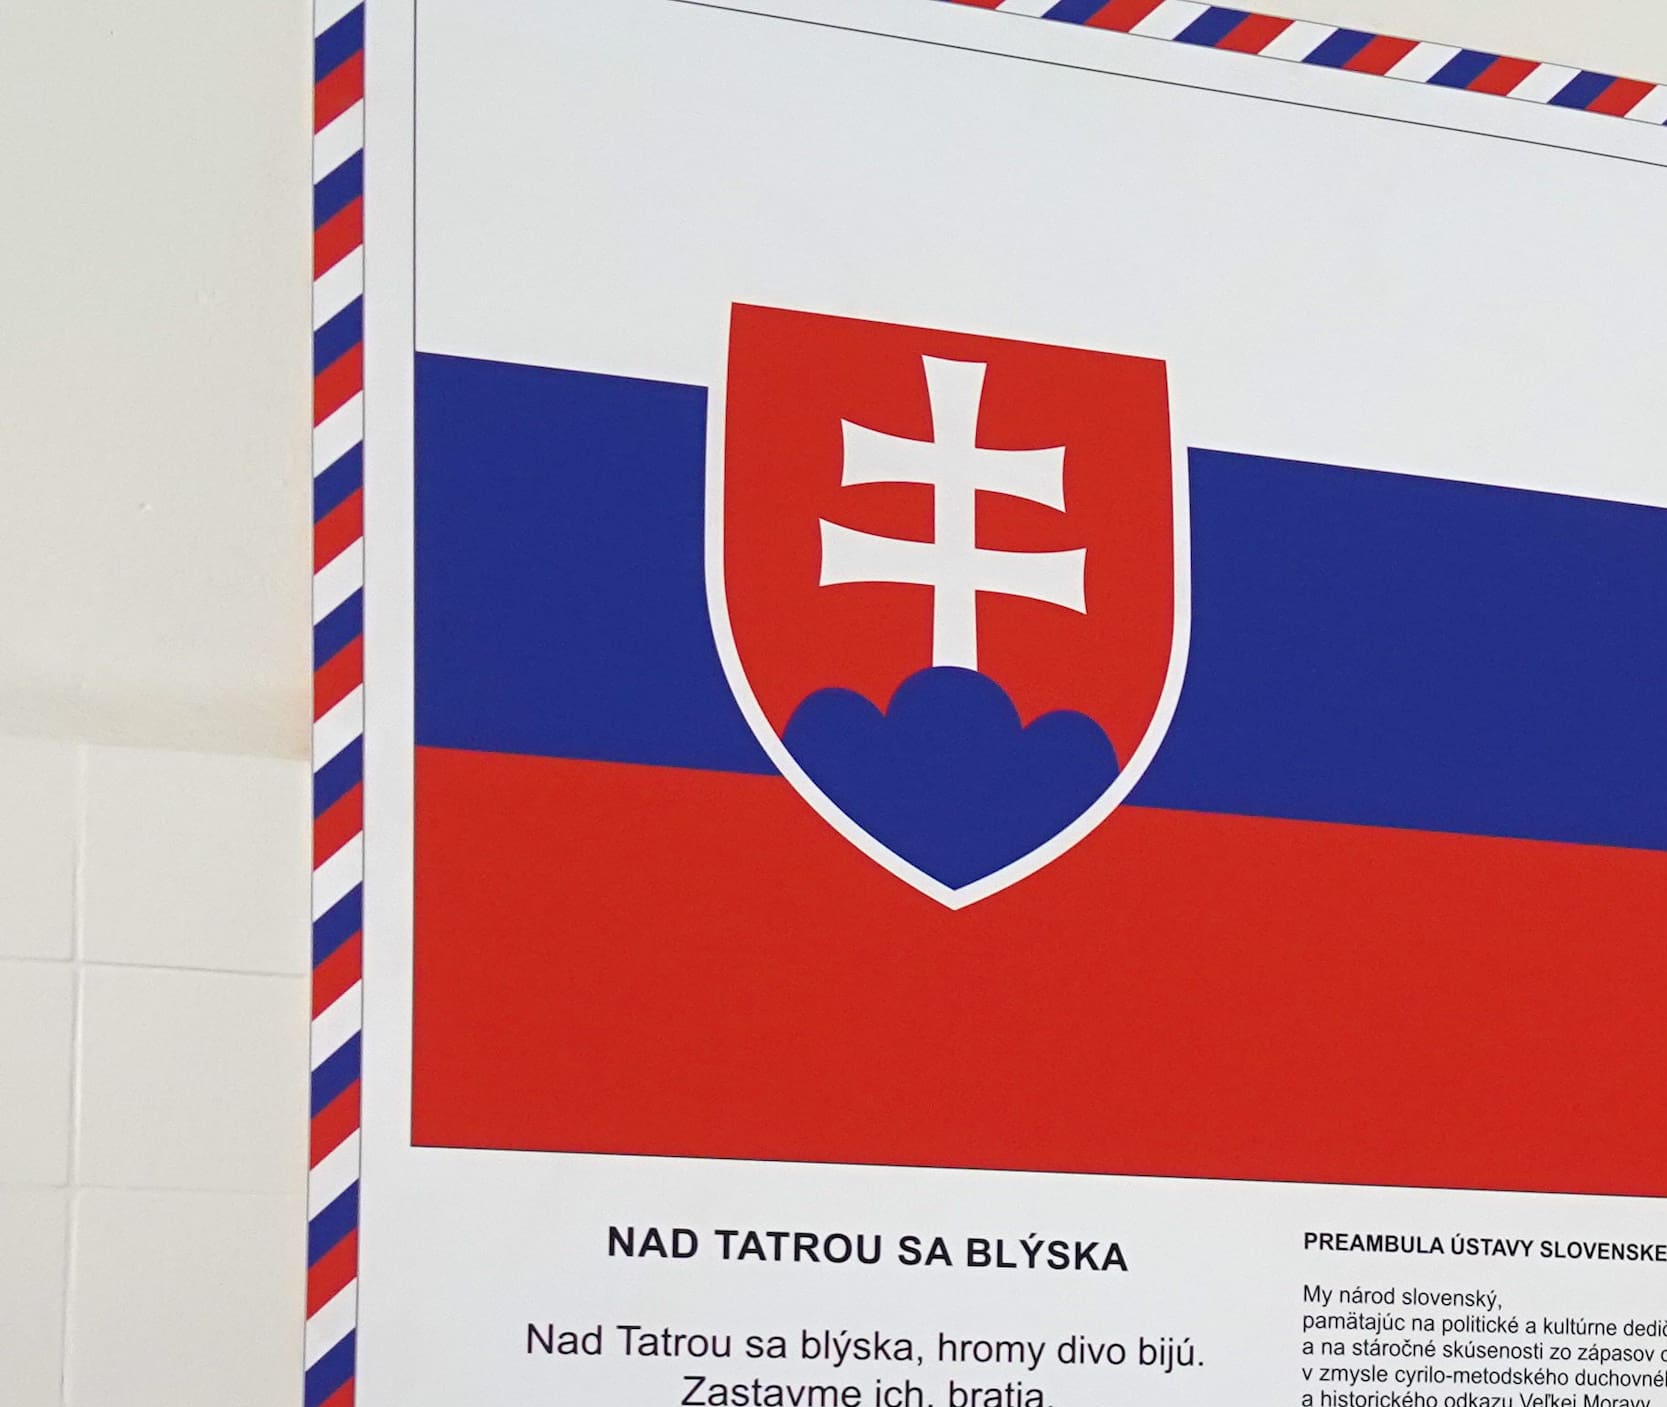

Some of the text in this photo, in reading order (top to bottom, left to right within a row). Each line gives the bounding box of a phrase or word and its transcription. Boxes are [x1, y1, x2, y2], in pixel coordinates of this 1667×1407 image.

[608, 1225, 1128, 1272] NAD TATROU SA BLÝSKA
[1304, 1231, 1445, 1255] PREAMBULA
[1451, 1233, 1534, 1258] ÚSTAVY
[1304, 1283, 1502, 1312] My národ slovenský,
[1303, 1311, 1405, 1336] pamätajúc
[1412, 1317, 1435, 1333] na
[1442, 1314, 1519, 1337] politické
[1525, 1320, 1536, 1334] a
[1544, 1316, 1617, 1337] kultúrne
[527, 1322, 1203, 1374] Nad Tatrou sa blýska, hromy divo bijú.
[1302, 1367, 1313, 1381] v
[1319, 1363, 1388, 1387] zmysle
[1395, 1365, 1568, 1388] cyrilo-metodského
[1302, 1393, 1313, 1407] a
